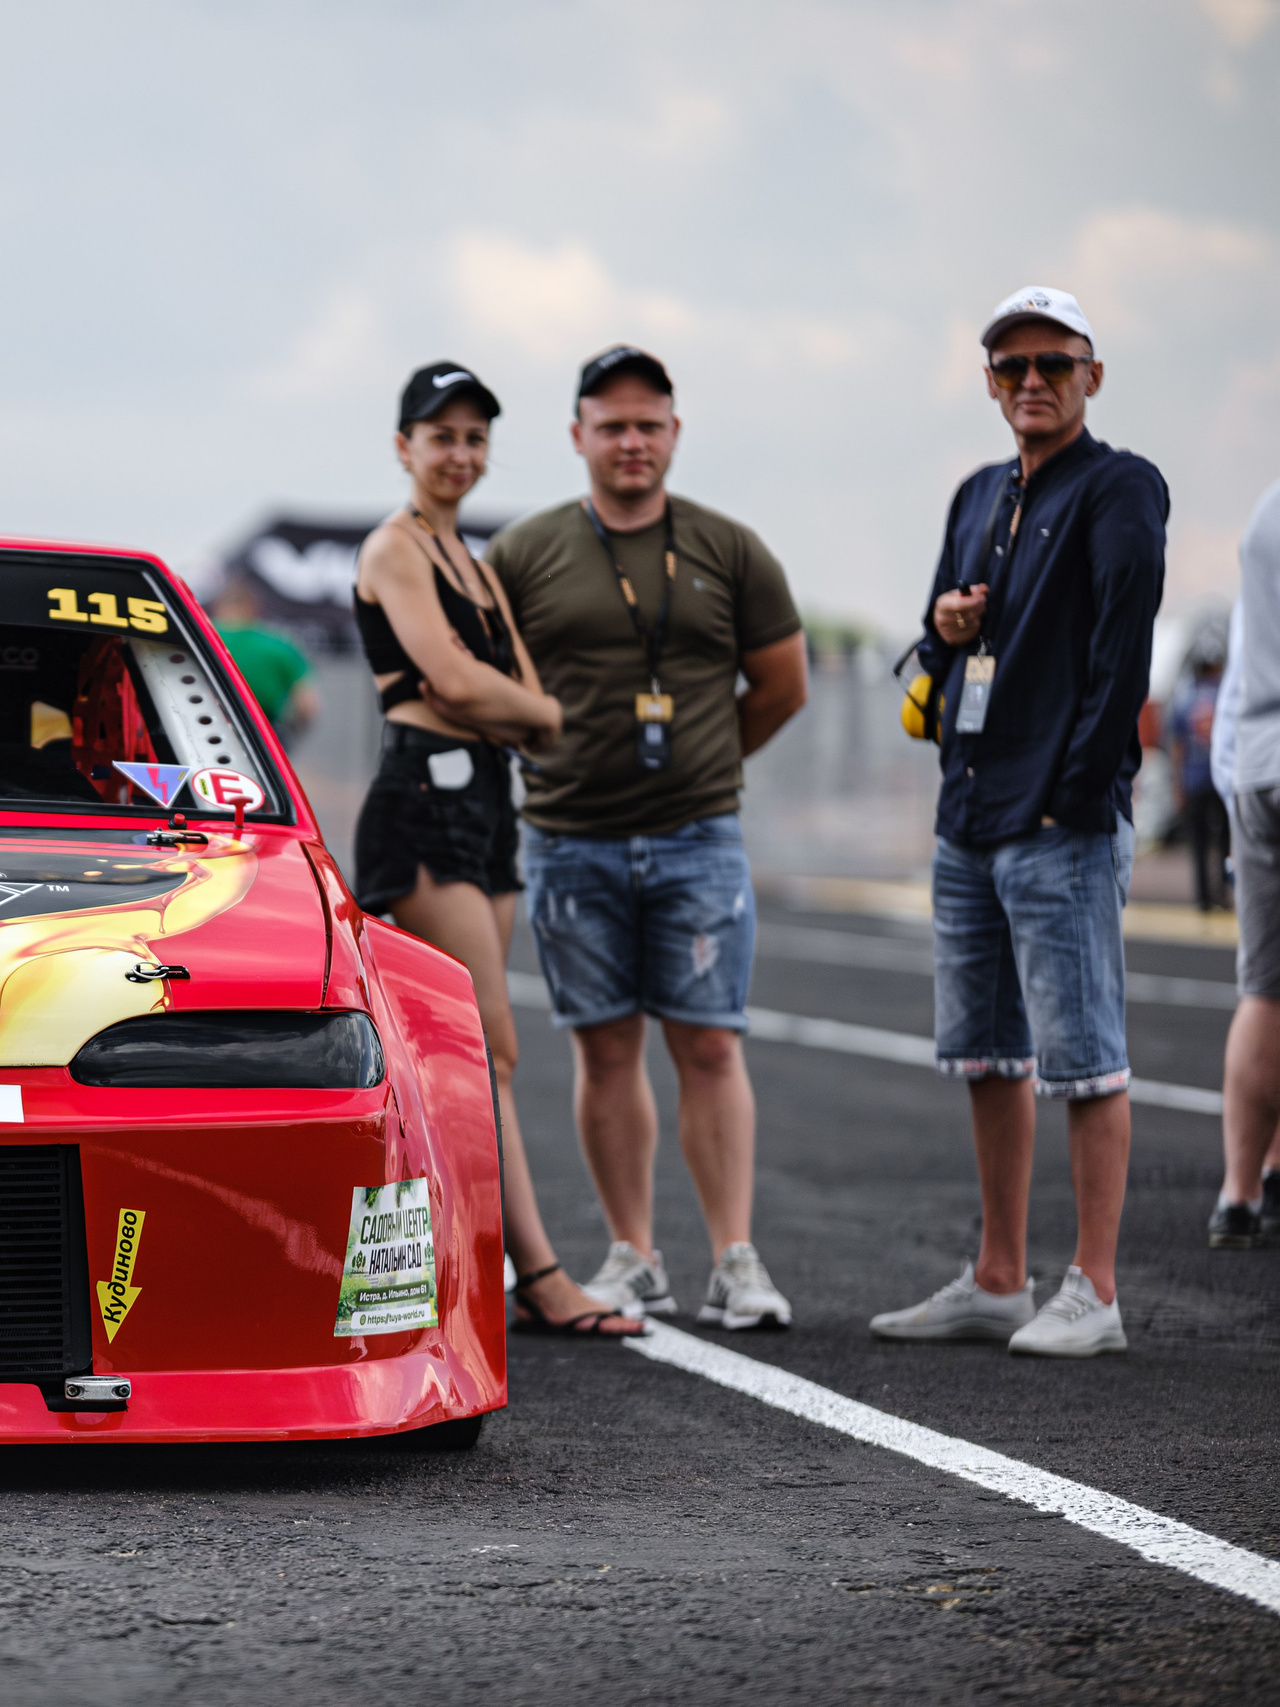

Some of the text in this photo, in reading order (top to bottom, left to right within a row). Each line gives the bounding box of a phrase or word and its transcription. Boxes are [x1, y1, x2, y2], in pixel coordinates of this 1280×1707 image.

[47, 587, 169, 634] 115
[209, 772, 245, 804] E
[402, 1206, 428, 1239] ЦЕНТР
[103, 1211, 138, 1324] Кудиново
[369, 1241, 422, 1275] НАТАЛЬИН САД
[359, 1291, 381, 1303] Истра,
[420, 1283, 427, 1294] 61
